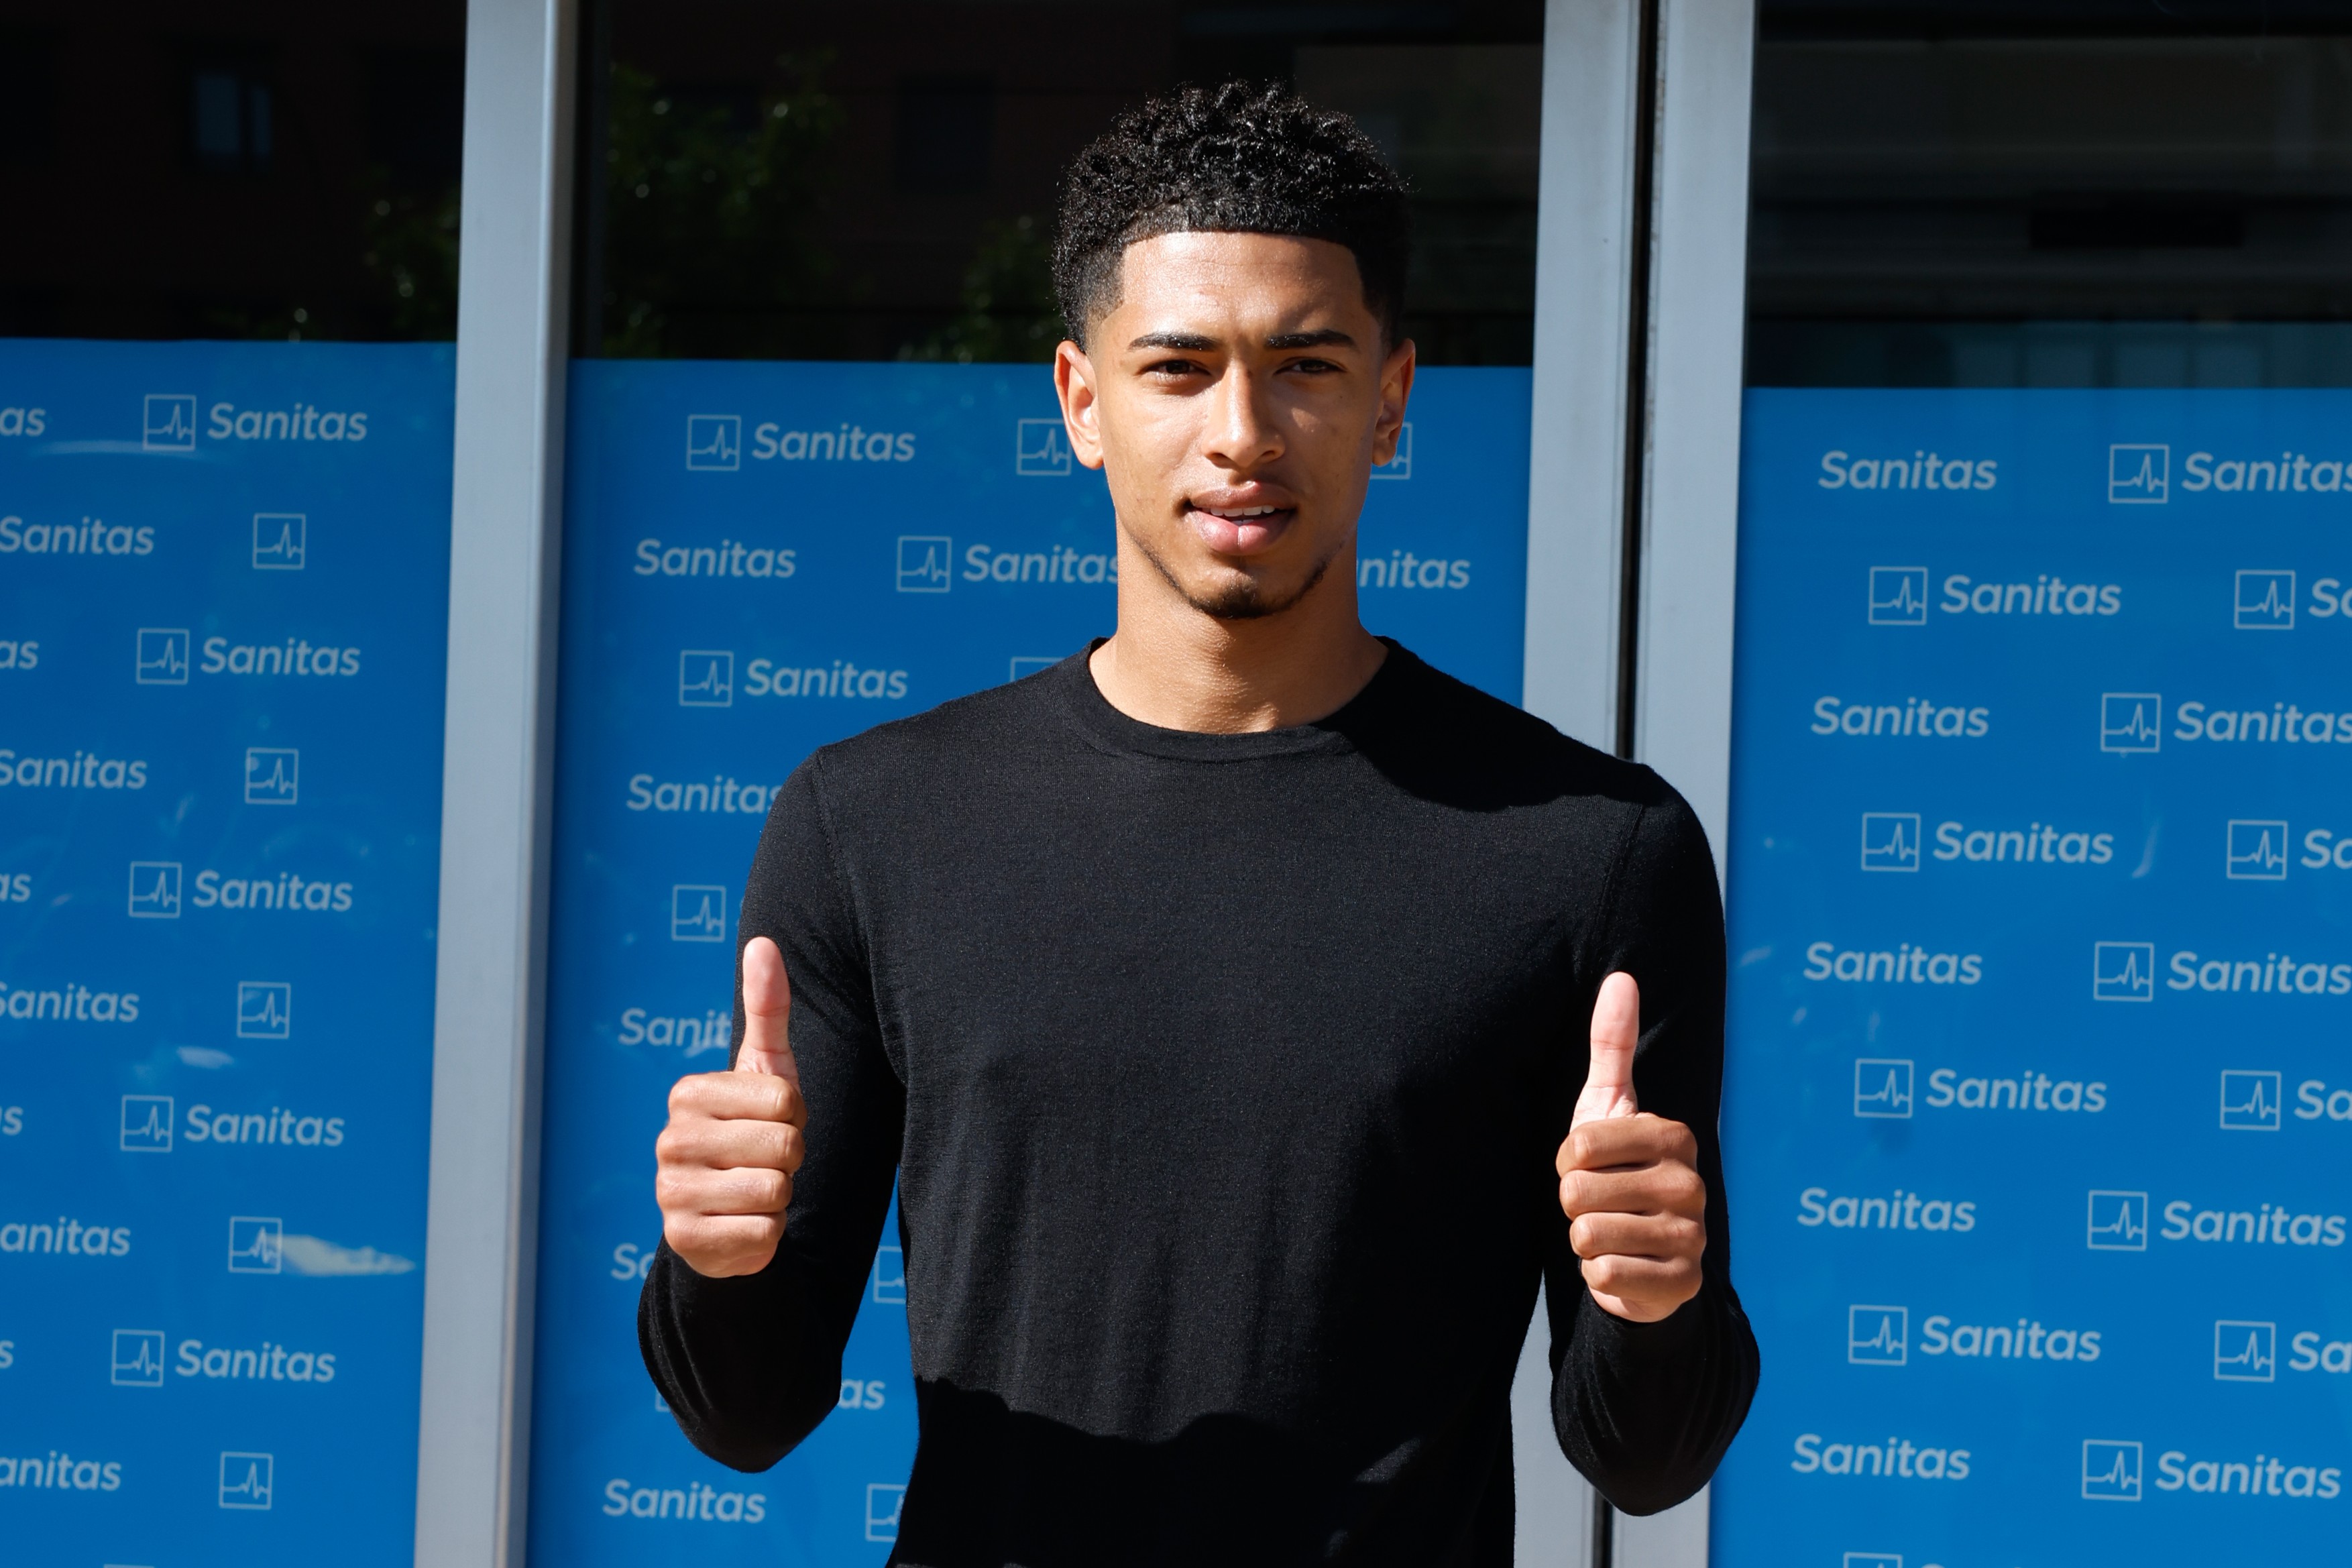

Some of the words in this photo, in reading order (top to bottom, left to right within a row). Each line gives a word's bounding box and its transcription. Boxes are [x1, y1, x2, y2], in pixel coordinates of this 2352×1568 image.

[208, 403, 367, 441] Sanitas
[752, 423, 915, 461] Sanitas
[1819, 451, 1997, 490] Sanitas
[0, 516, 154, 554] Sanitas
[634, 539, 795, 577] Sanitas
[1357, 550, 1469, 589] nitas
[1941, 575, 2121, 614] Sanitas
[201, 637, 359, 675] Sanitas
[745, 659, 907, 699] Sanitas
[1811, 697, 1989, 736] Sanitas
[1934, 822, 2113, 863] Sanitas
[193, 870, 352, 911] Sanitas
[1804, 942, 1982, 984] Sanitas
[2168, 952, 2352, 994] Sanitas
[0, 982, 139, 1021] anitas
[1926, 1069, 2106, 1112] Sanitas
[184, 1105, 343, 1145] Sanitas
[1798, 1188, 1975, 1231] Sanitas
[2161, 1201, 2345, 1246] Sanitas
[1921, 1316, 2101, 1361] Sanitas
[176, 1340, 335, 1382] Sanitas
[1791, 1434, 1970, 1479] Sanitas
[2155, 1451, 2341, 1498] Sanitas
[604, 1479, 765, 1522] Sanitas
